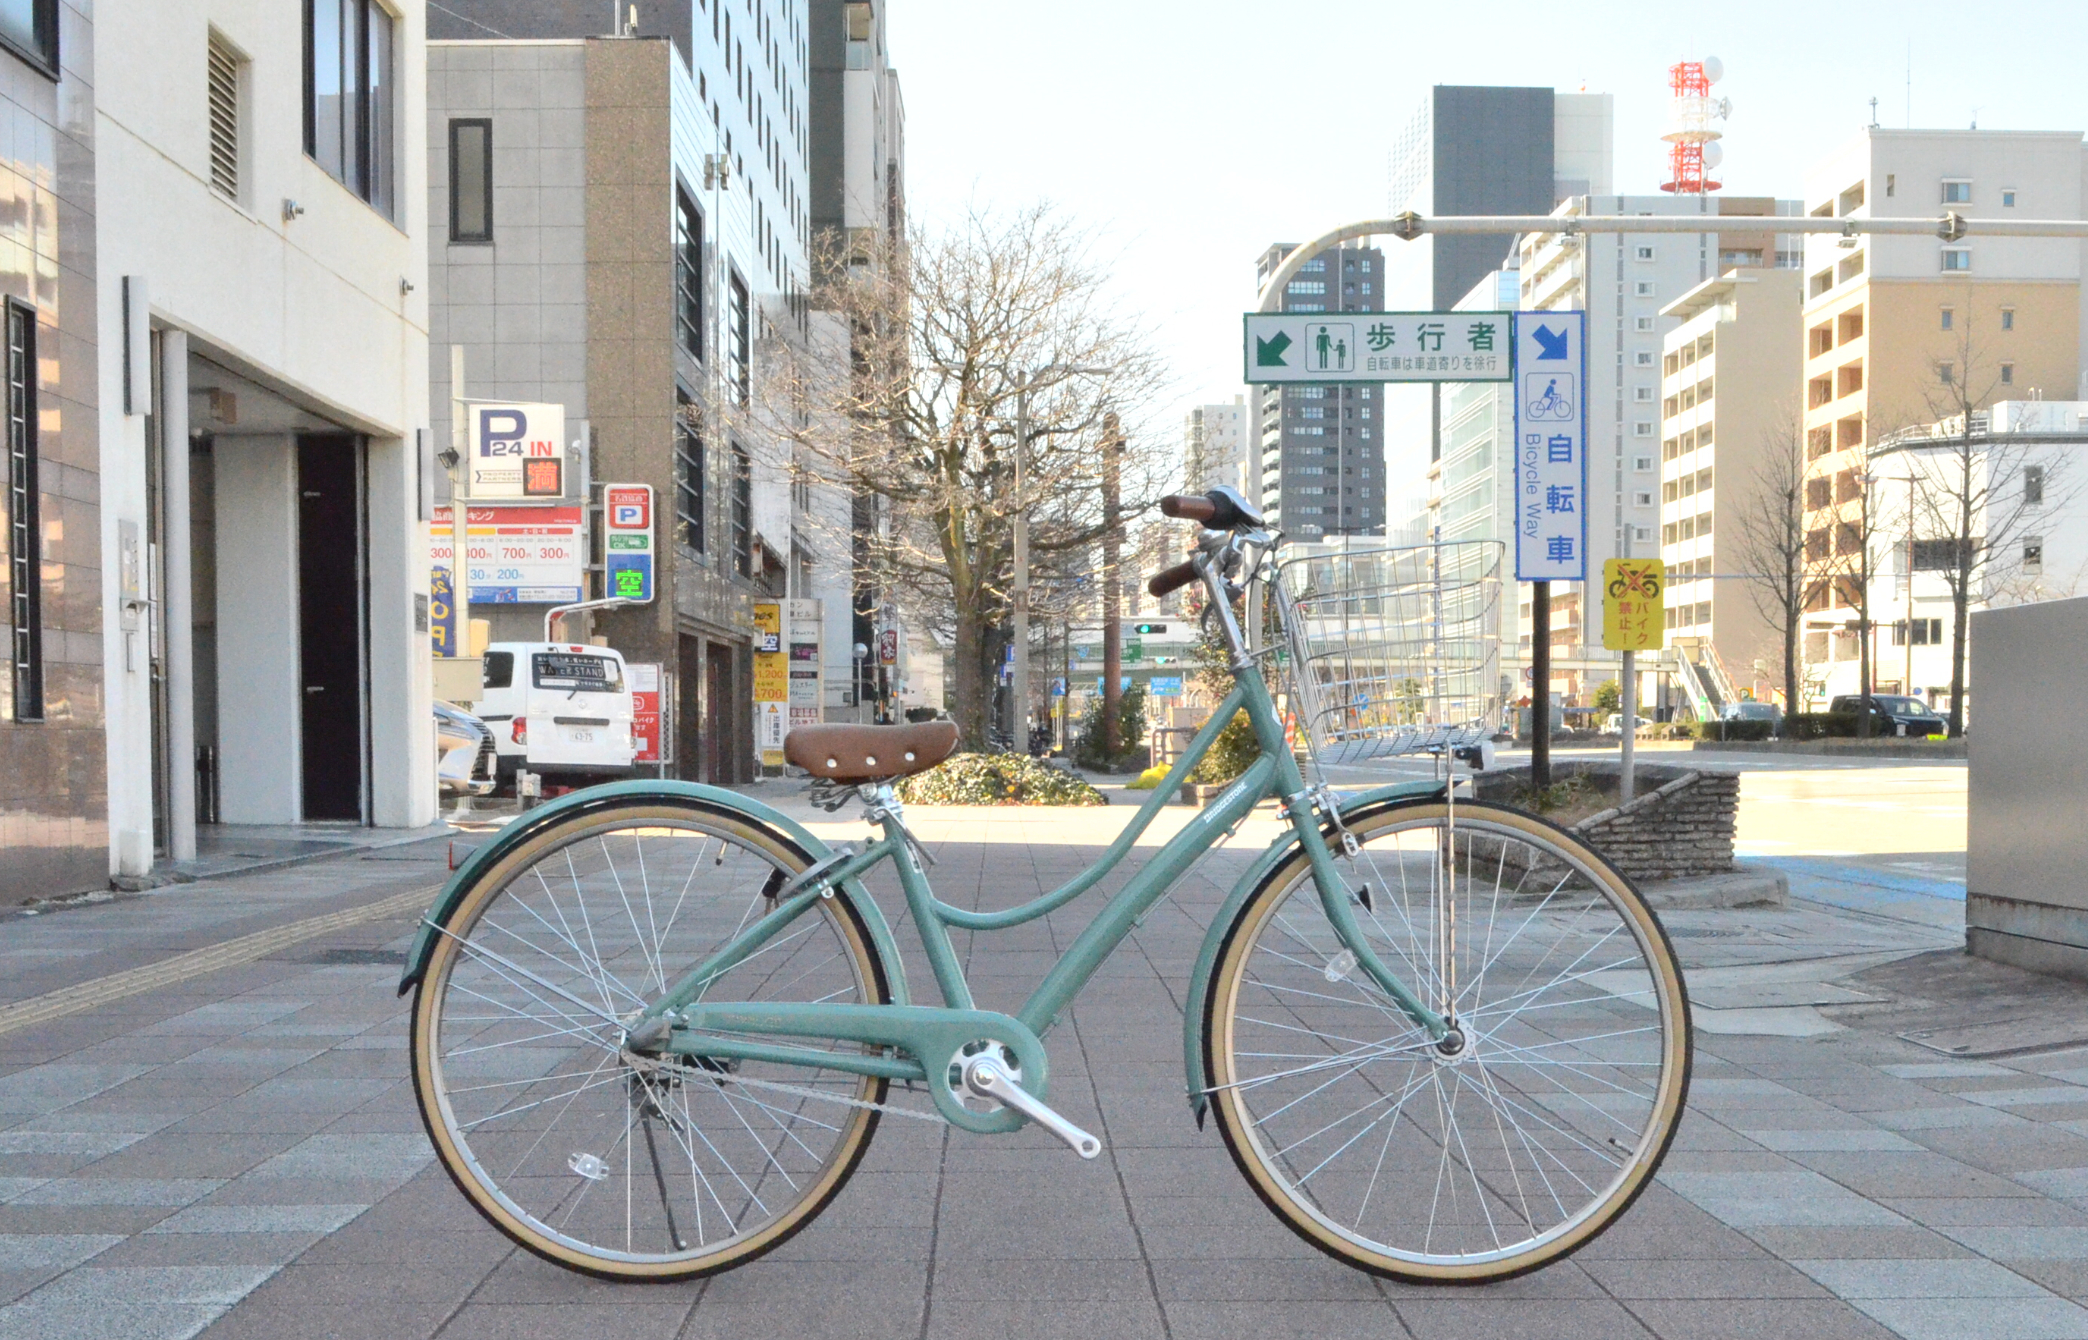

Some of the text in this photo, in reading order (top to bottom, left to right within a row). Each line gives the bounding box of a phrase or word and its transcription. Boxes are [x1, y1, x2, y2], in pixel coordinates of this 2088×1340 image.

[1366, 321, 1496, 351] 歩行者
[1366, 356, 1496, 372] 自転車は車道寄りを徐行
[480, 409, 527, 457] P
[492, 441, 552, 457] 24 IN
[527, 461, 558, 491] 満
[1523, 433, 1541, 539] Bicycle Way
[1546, 433, 1575, 564] 自転車
[620, 508, 637, 522] P
[615, 569, 643, 596] 空
[1636, 602, 1649, 645] バイク
[575, 667, 604, 677] STAND
[1203, 781, 1247, 824] BRIDGESTONE
